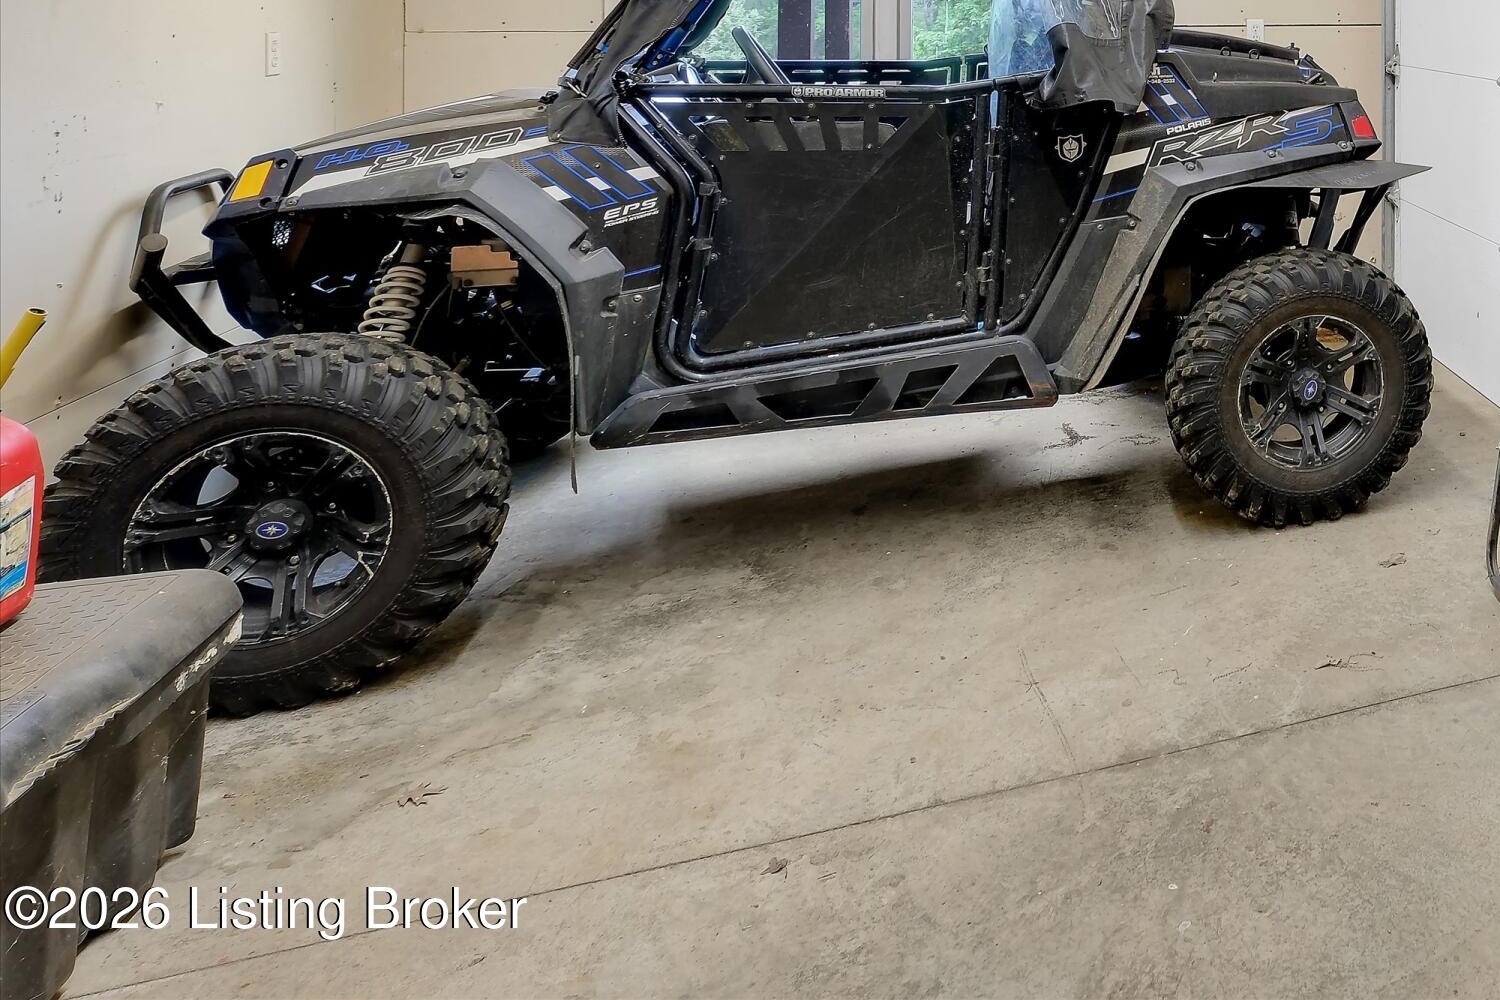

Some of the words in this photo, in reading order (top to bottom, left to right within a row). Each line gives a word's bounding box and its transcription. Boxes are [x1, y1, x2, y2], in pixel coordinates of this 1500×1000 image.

[805, 87, 833, 97] PRO
[835, 88, 885, 97] ARMOR
[1166, 117, 1212, 136] POLARIS
[363, 126, 524, 177] 800
[603, 197, 658, 220] EPS
